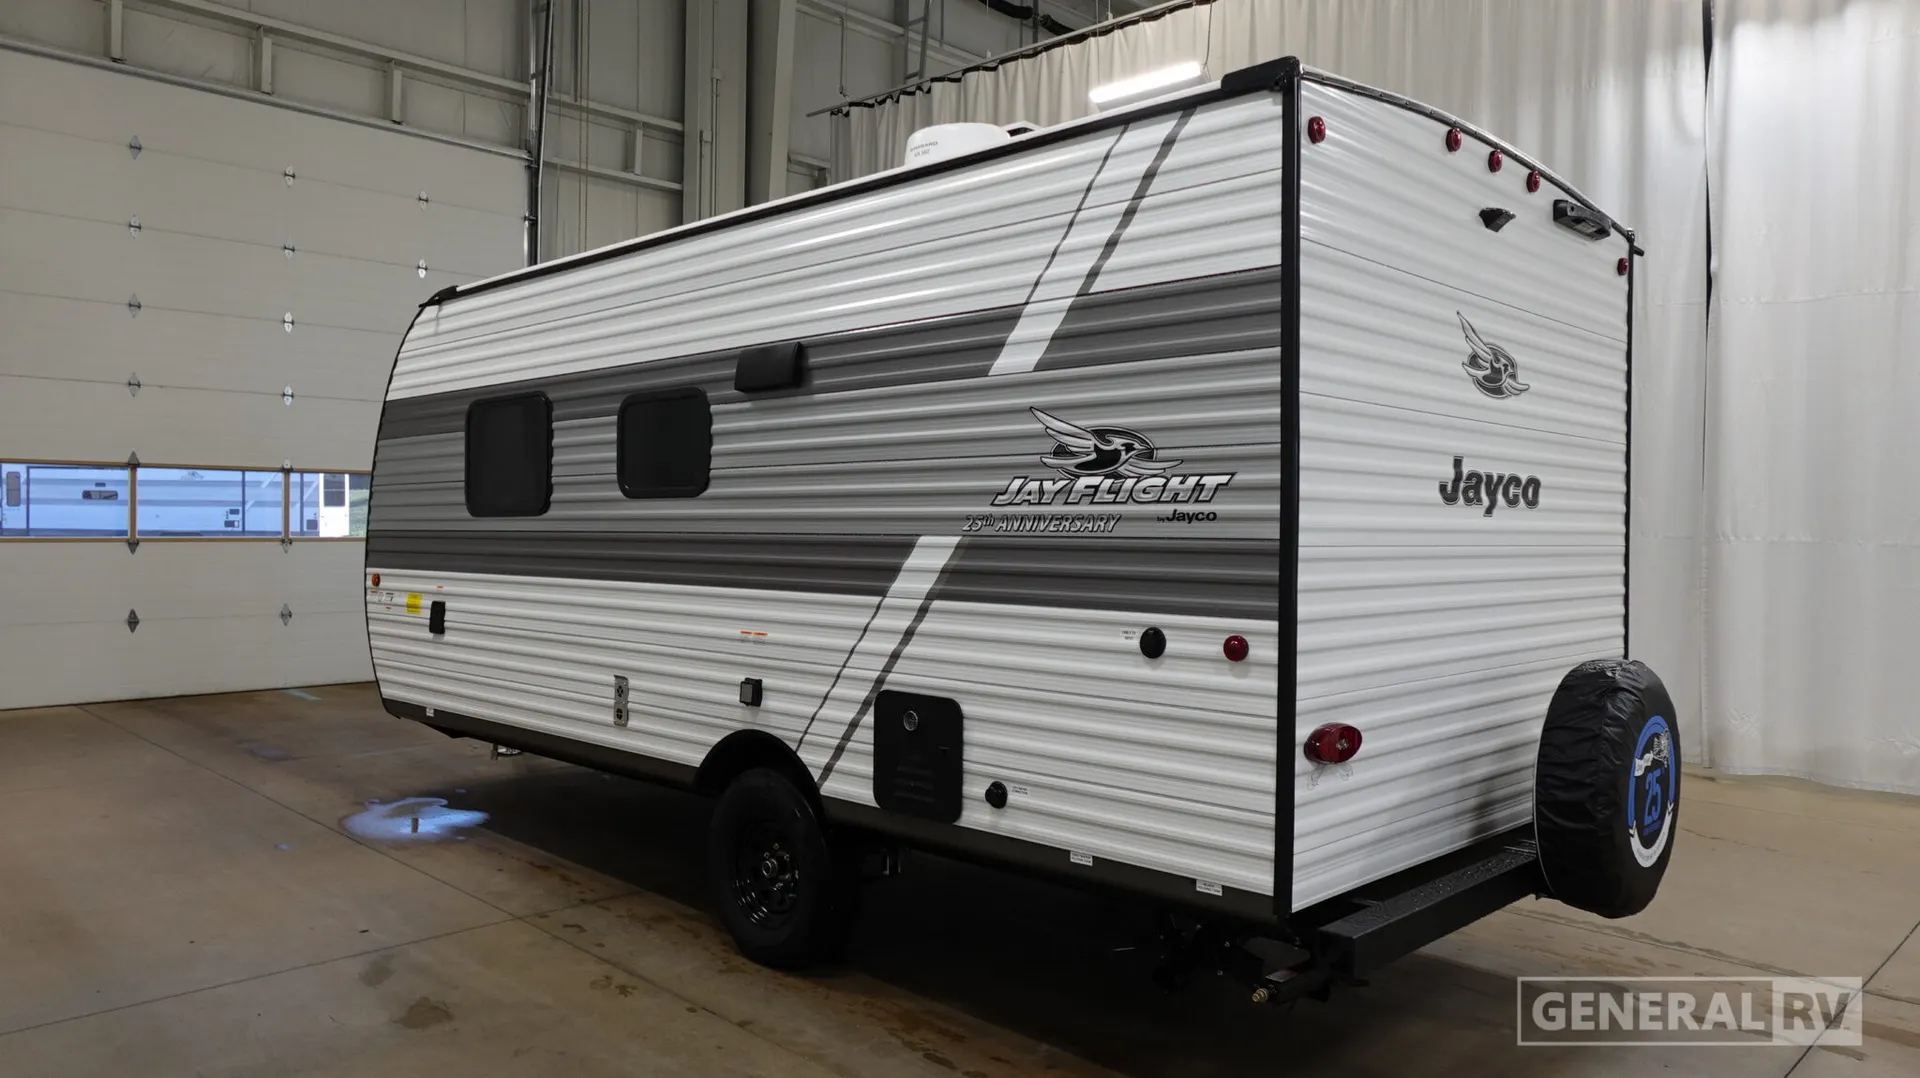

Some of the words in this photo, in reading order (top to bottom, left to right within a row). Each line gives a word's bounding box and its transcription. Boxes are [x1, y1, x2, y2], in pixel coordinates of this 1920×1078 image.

[990, 476, 1072, 506] JAY
[1064, 472, 1237, 505] FLIGHT
[1439, 456, 1541, 517] Jayco
[962, 514, 995, 532] 25th
[995, 514, 1121, 532] ANNIVERSARY
[1166, 509, 1217, 524] Jayco
[1644, 768, 1664, 826] 25
